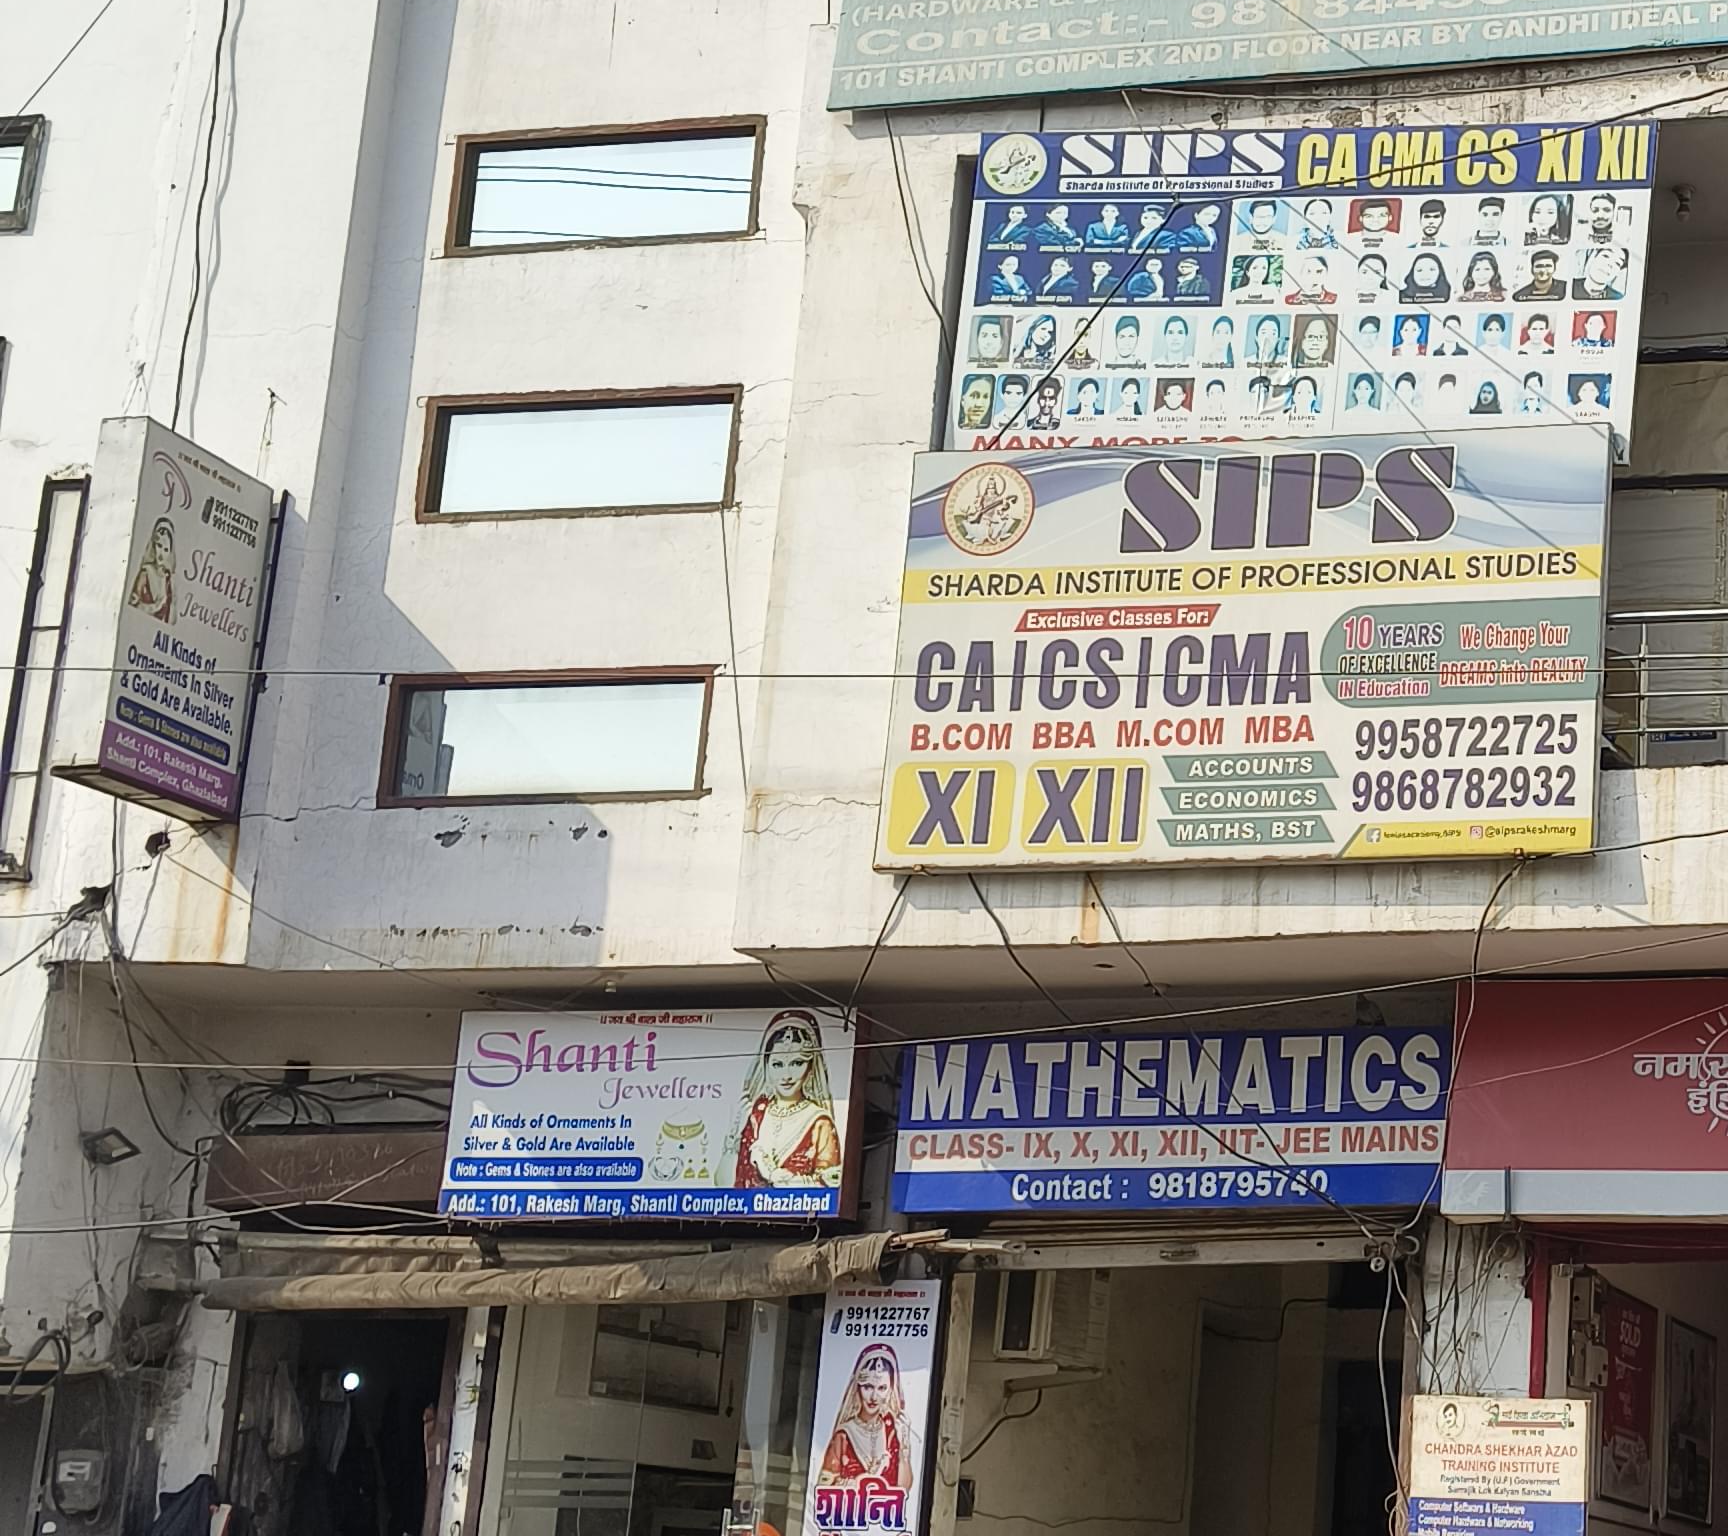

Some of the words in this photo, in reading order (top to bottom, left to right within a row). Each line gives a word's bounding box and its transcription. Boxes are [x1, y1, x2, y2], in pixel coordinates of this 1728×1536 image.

[1059, 132, 1287, 176] SIPS
[1297, 133, 1356, 190] CA
[1368, 131, 1445, 187] CMA
[1456, 129, 1517, 186] CS
[1536, 128, 1589, 184] XI
[1596, 125, 1650, 183] XII
[1065, 180, 1104, 192] Sharda
[1106, 179, 1150, 191] Institute
[1151, 179, 1164, 191] Of
[1165, 179, 1232, 191] Professional
[1235, 177, 1275, 190] Studies
[1120, 445, 1458, 554] SIPS
[184, 550, 257, 608] Shanti
[928, 572, 1046, 599] SHARDA
[1055, 569, 1182, 595] INSTITUTE
[1192, 567, 1232, 591] OF
[1241, 556, 1456, 590] PROFESSIONAL
[1464, 551, 1578, 579] STUDIES
[179, 592, 249, 643] Jewellers
[910, 722, 1012, 752] B.COM
[1032, 719, 1096, 749] BBA
[1116, 717, 1224, 749] M.COM
[1244, 714, 1315, 743] MBA
[1354, 713, 1578, 761] 9958722725
[1188, 756, 1314, 779] ACCOUNTS
[909, 770, 995, 846] XI
[1029, 767, 1143, 844] XII
[1178, 787, 1319, 811] ECONOMICS
[1351, 765, 1577, 814] 9868782932
[1175, 820, 1262, 844] MATHS,
[1270, 819, 1316, 840] BST
[466, 1029, 661, 1088] Shanti
[909, 1034, 1441, 1121] MATHEMATICS
[598, 1076, 722, 1109] Jewellers
[909, 1132, 1014, 1161] CLASS-
[1023, 1132, 1061, 1164] IX,
[1070, 1131, 1099, 1162] X,
[1109, 1130, 1148, 1162] XI,
[1158, 1129, 1208, 1162] XII,
[1219, 1128, 1265, 1155] IIT-
[1276, 1127, 1331, 1154] JEE
[1341, 1124, 1439, 1153] MAINS
[448, 1194, 486, 1214] Add.:
[490, 1195, 522, 1216] 101,
[526, 1194, 579, 1214] Rakesh
[585, 1195, 627, 1216] Marg,
[630, 1193, 678, 1213] Shanti
[682, 1194, 748, 1216] Complex,
[753, 1193, 830, 1212] Ghaziabad
[1012, 1173, 1112, 1202] Contact
[1148, 1170, 1328, 1199] 9818795740
[845, 1323, 928, 1337] 9911227756
[847, 1306, 930, 1321] 9911227767
[1425, 1443, 1482, 1455] CHANDRA
[1485, 1444, 1542, 1457] SHEKHAR
[1545, 1445, 1578, 1457] AZAD
[1441, 1461, 1496, 1472] TRAINING
[1500, 1461, 1560, 1473] INSTITUTE
[817, 1477, 905, 1528] शान्ति
